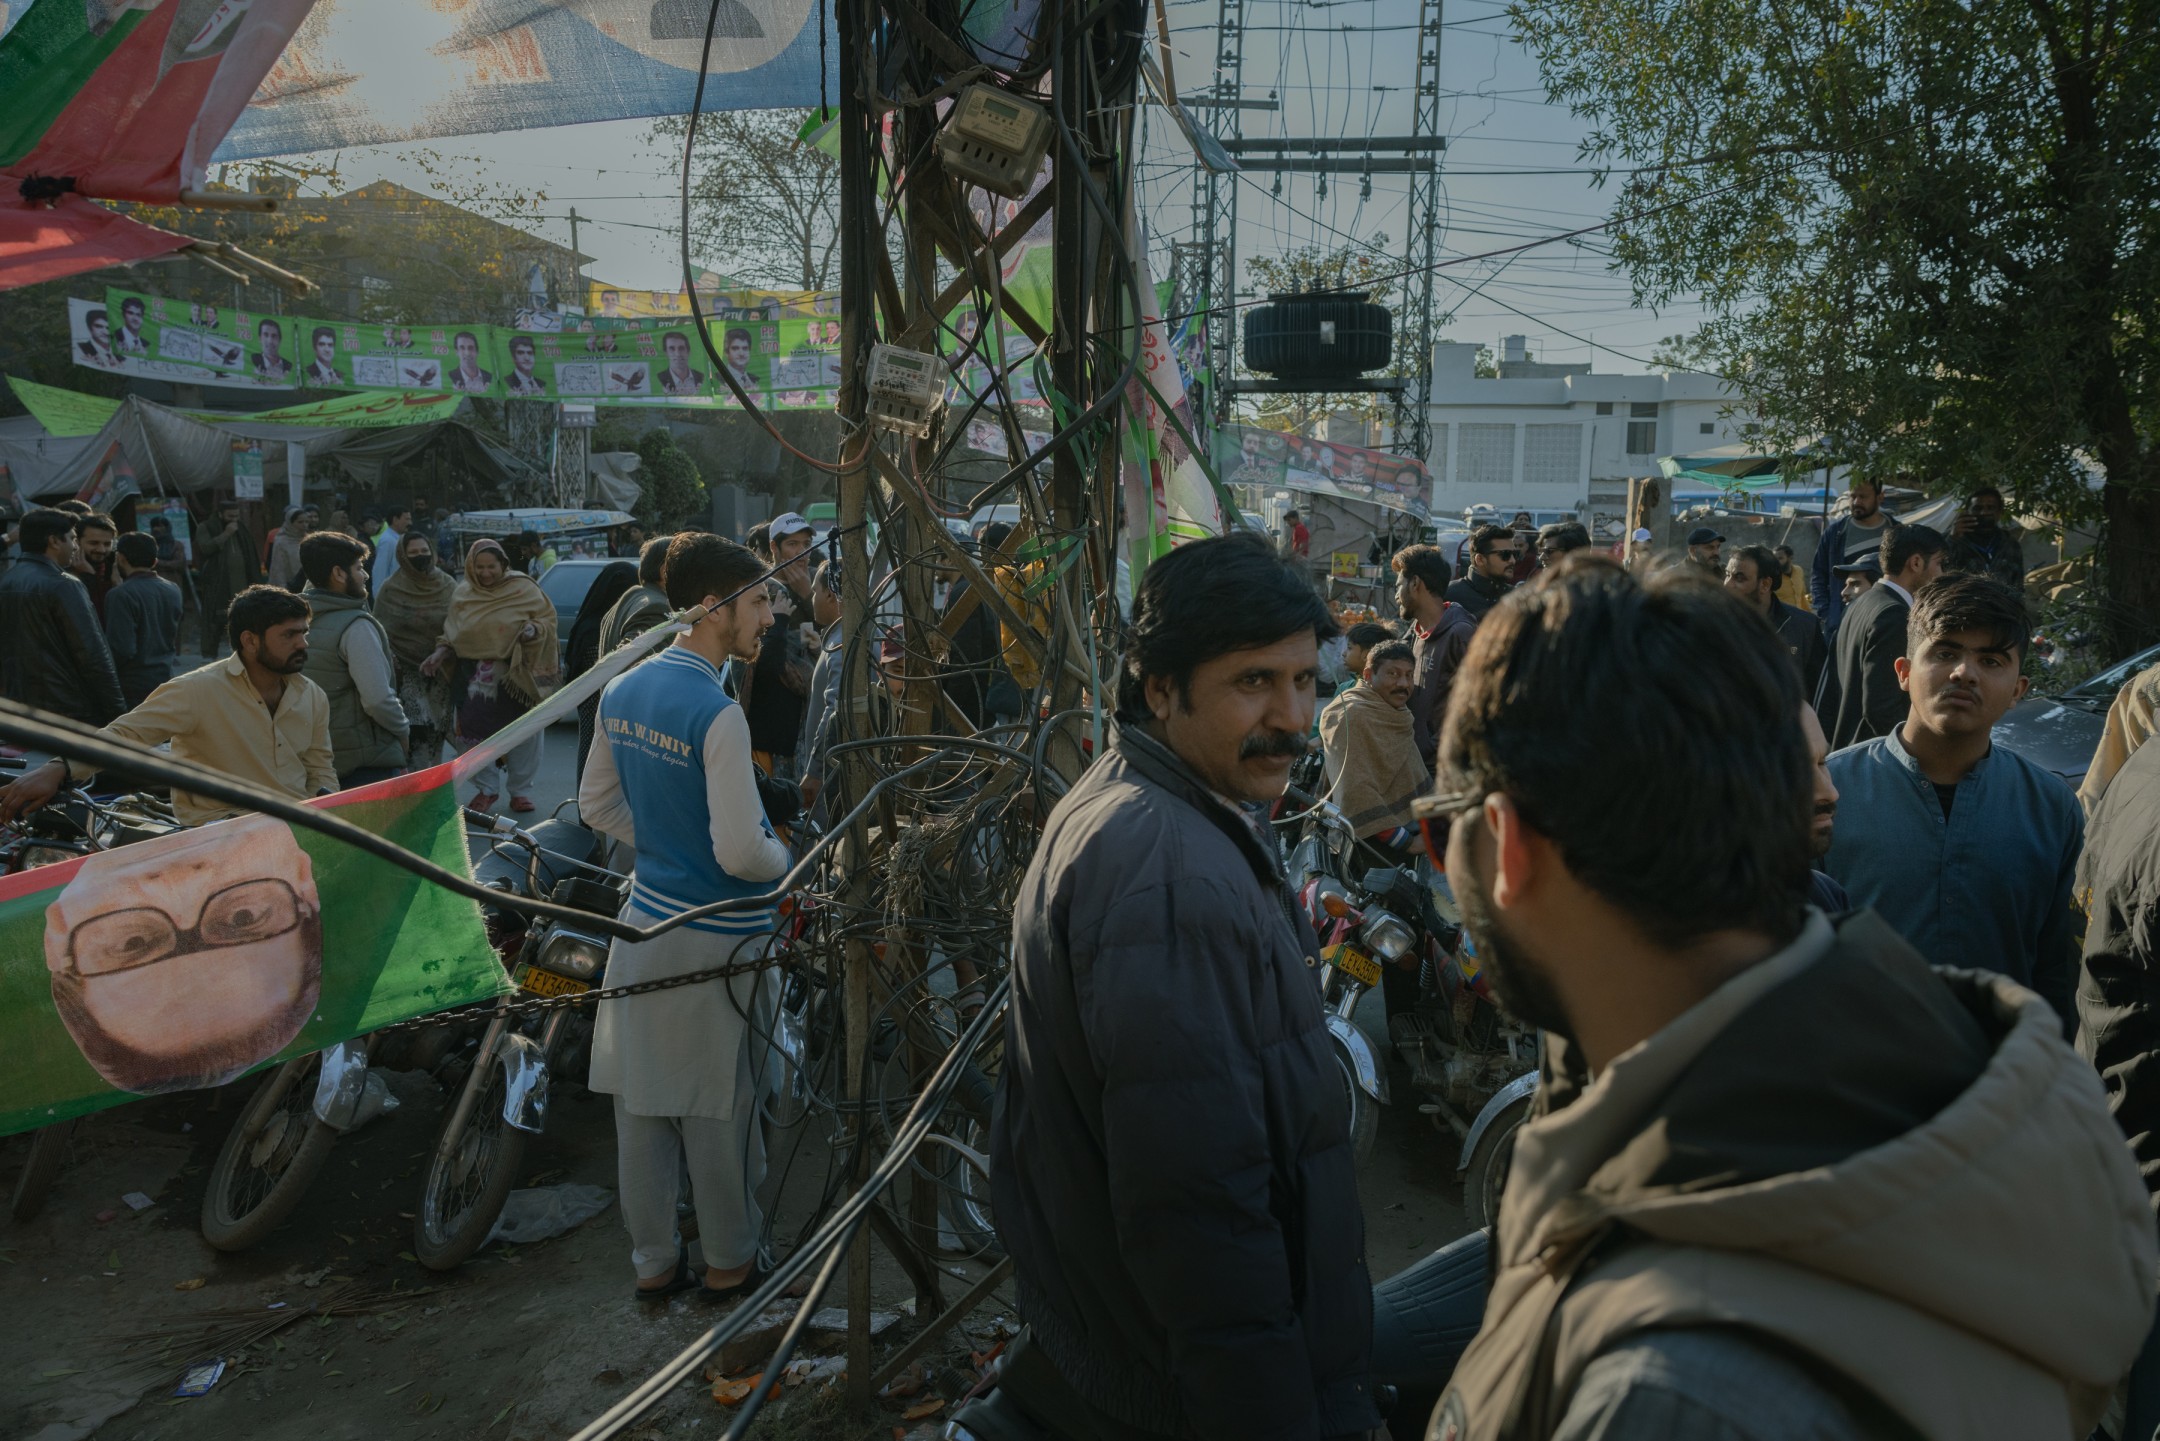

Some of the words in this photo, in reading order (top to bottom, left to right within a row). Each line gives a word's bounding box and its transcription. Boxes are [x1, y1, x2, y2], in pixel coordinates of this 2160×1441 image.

[725, 311, 738, 319] PTI
[431, 330, 446, 341] NA
[761, 325, 776, 338] PP
[638, 346, 657, 357] 128
[760, 341, 779, 353] 170
[661, 752, 689, 768] begins
